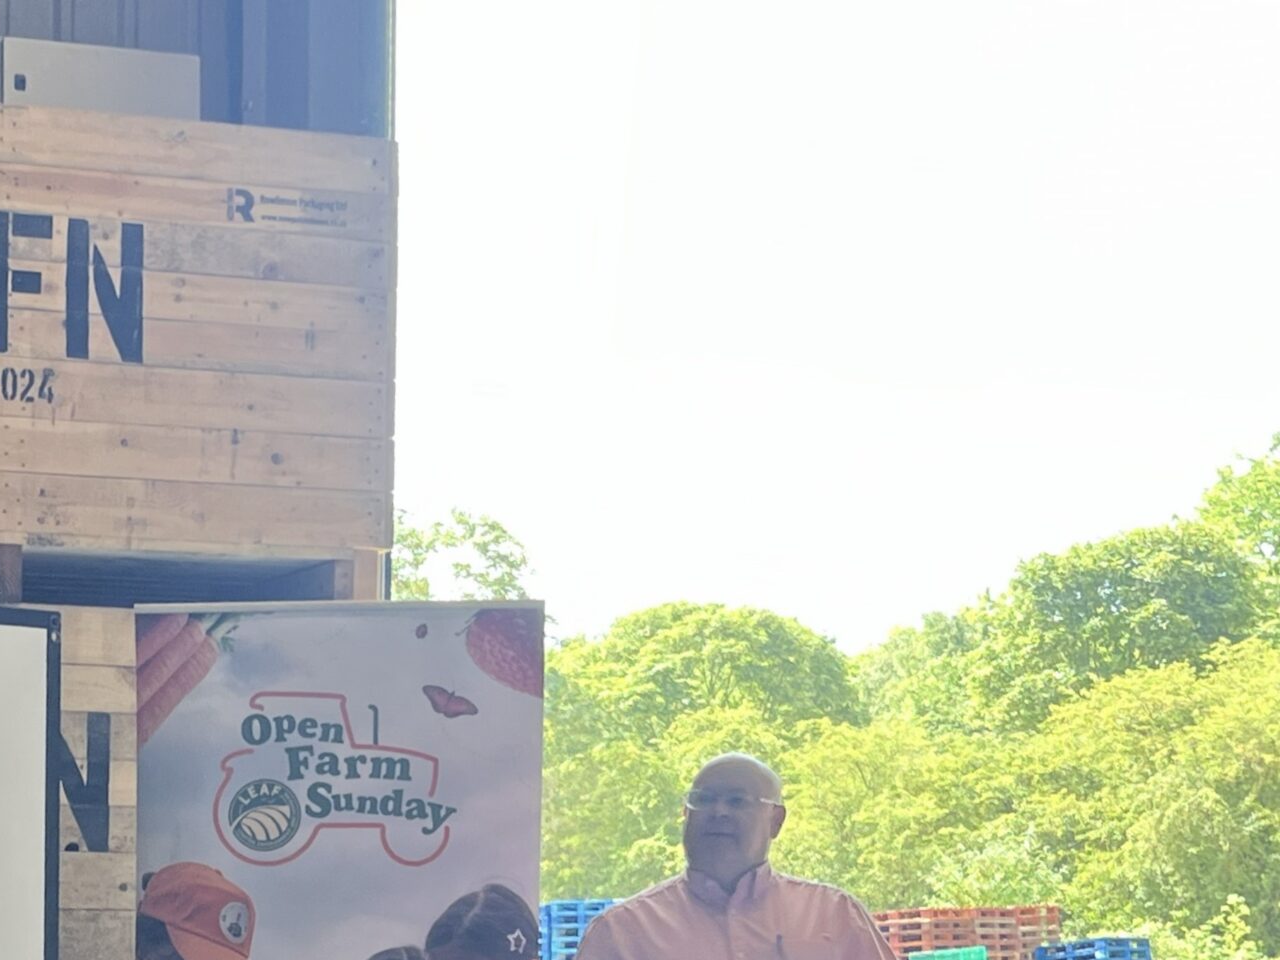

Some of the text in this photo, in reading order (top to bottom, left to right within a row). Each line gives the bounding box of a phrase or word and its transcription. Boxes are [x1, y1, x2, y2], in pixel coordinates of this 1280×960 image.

[226, 187, 256, 223] R
[240, 712, 345, 746] Open
[284, 744, 412, 782] Farm
[237, 781, 283, 806] LEAF
[305, 781, 458, 836] Sunday
